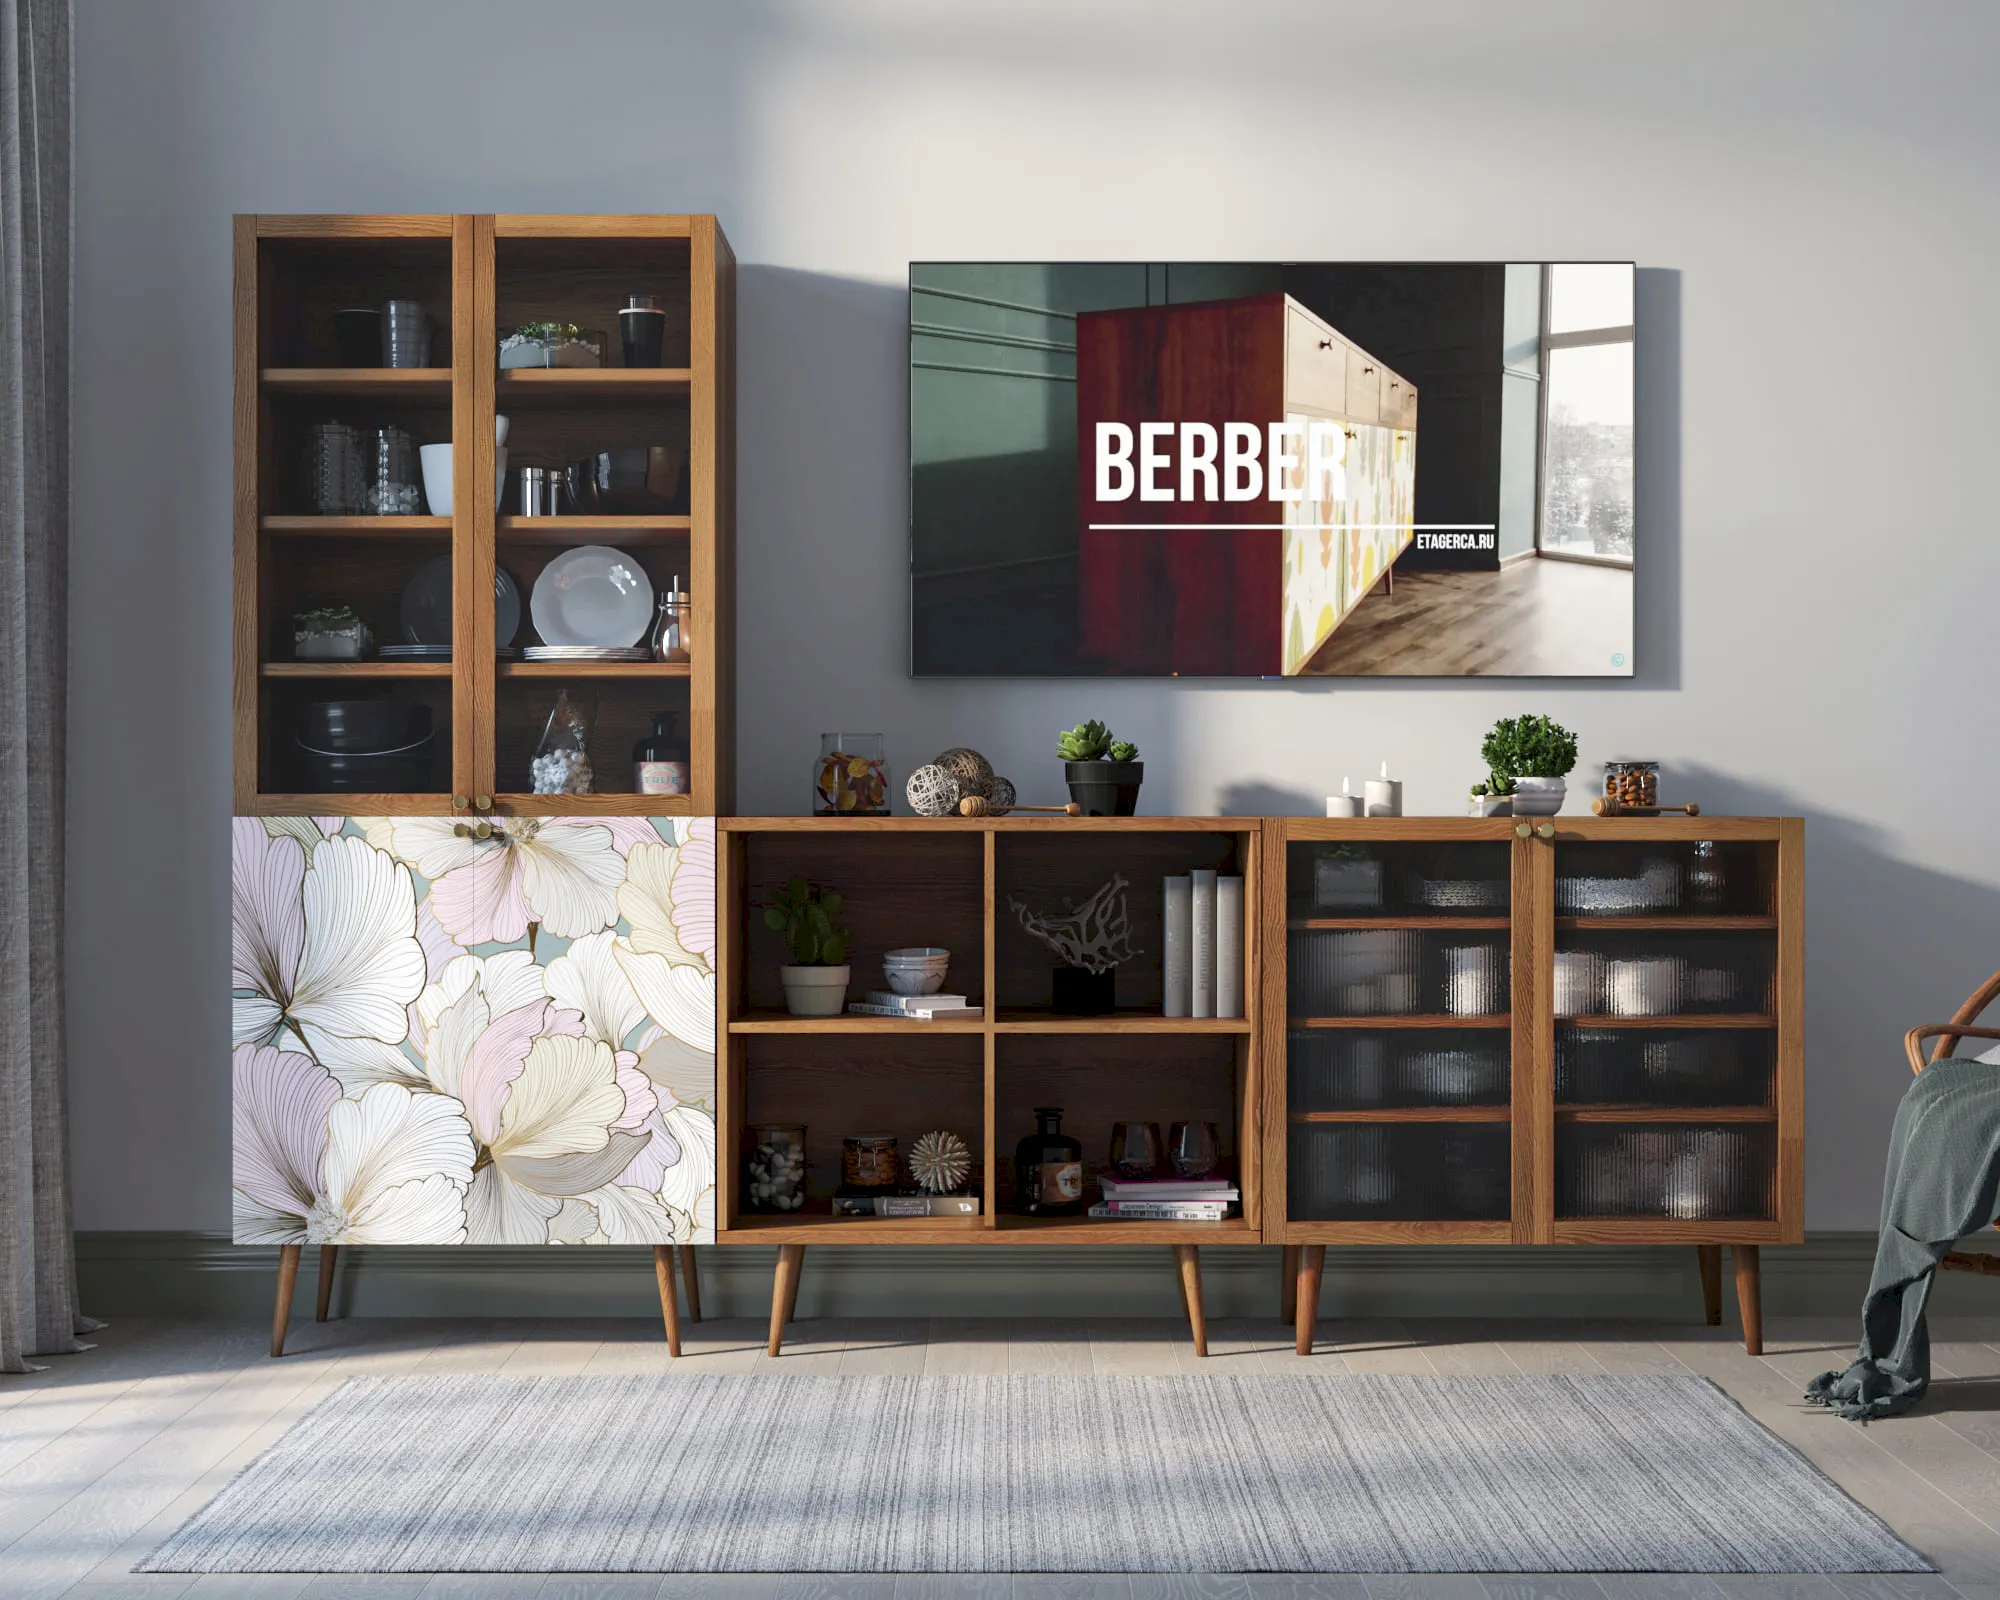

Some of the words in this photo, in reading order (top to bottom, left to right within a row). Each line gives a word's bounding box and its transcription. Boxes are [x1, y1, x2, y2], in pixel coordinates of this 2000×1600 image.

[1096, 421, 1347, 502] BERBER
[1417, 533, 1495, 549] ETAGERCA.RU
[641, 775, 680, 785] TRUE
